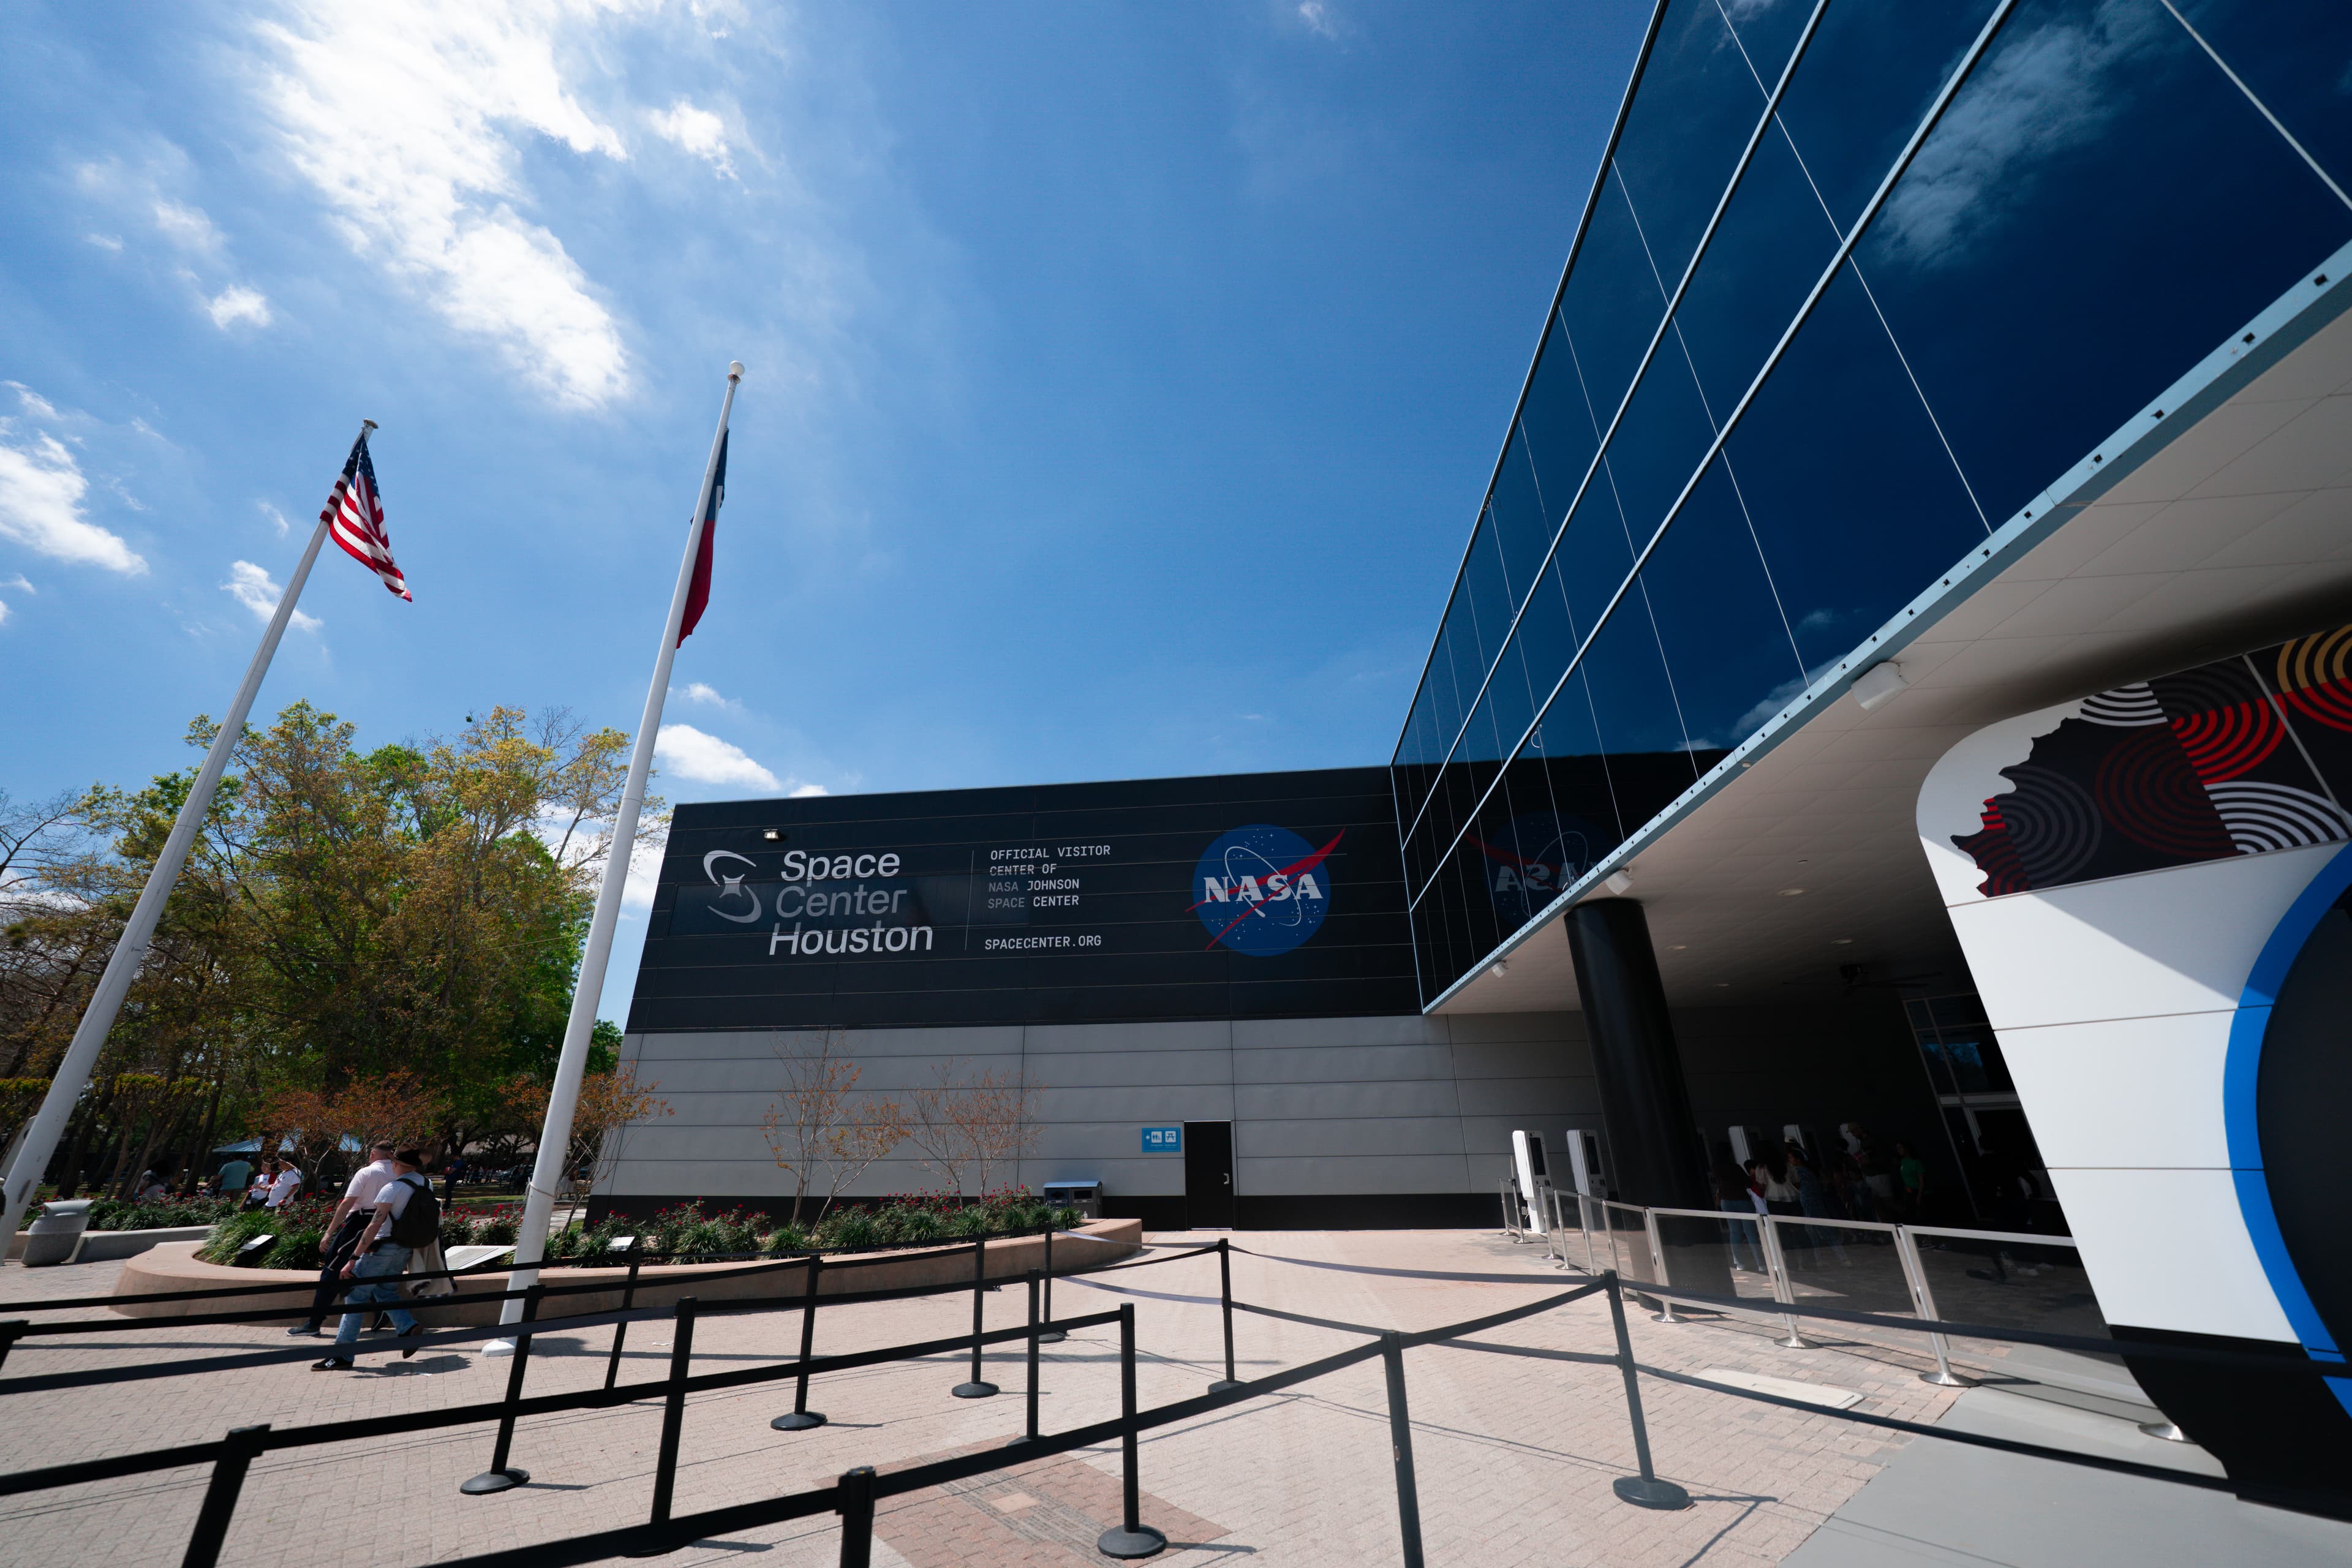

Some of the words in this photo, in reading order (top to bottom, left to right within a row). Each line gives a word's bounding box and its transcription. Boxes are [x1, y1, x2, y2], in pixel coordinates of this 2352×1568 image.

[990, 848, 1050, 861] OFFICIAL
[1057, 845, 1111, 858] VISITOR
[780, 850, 900, 888] Space
[989, 864, 1035, 876] CENTER
[1041, 863, 1057, 874] OF
[988, 881, 1019, 892] NASA
[1027, 878, 1080, 891] JOHNSON
[1203, 873, 1324, 903] NASA
[775, 884, 908, 918] Center
[987, 897, 1025, 909] SPACE
[1033, 895, 1080, 907] CENTER
[769, 920, 933, 956] Houston
[984, 935, 1102, 950] SPACECENTER.ORG
